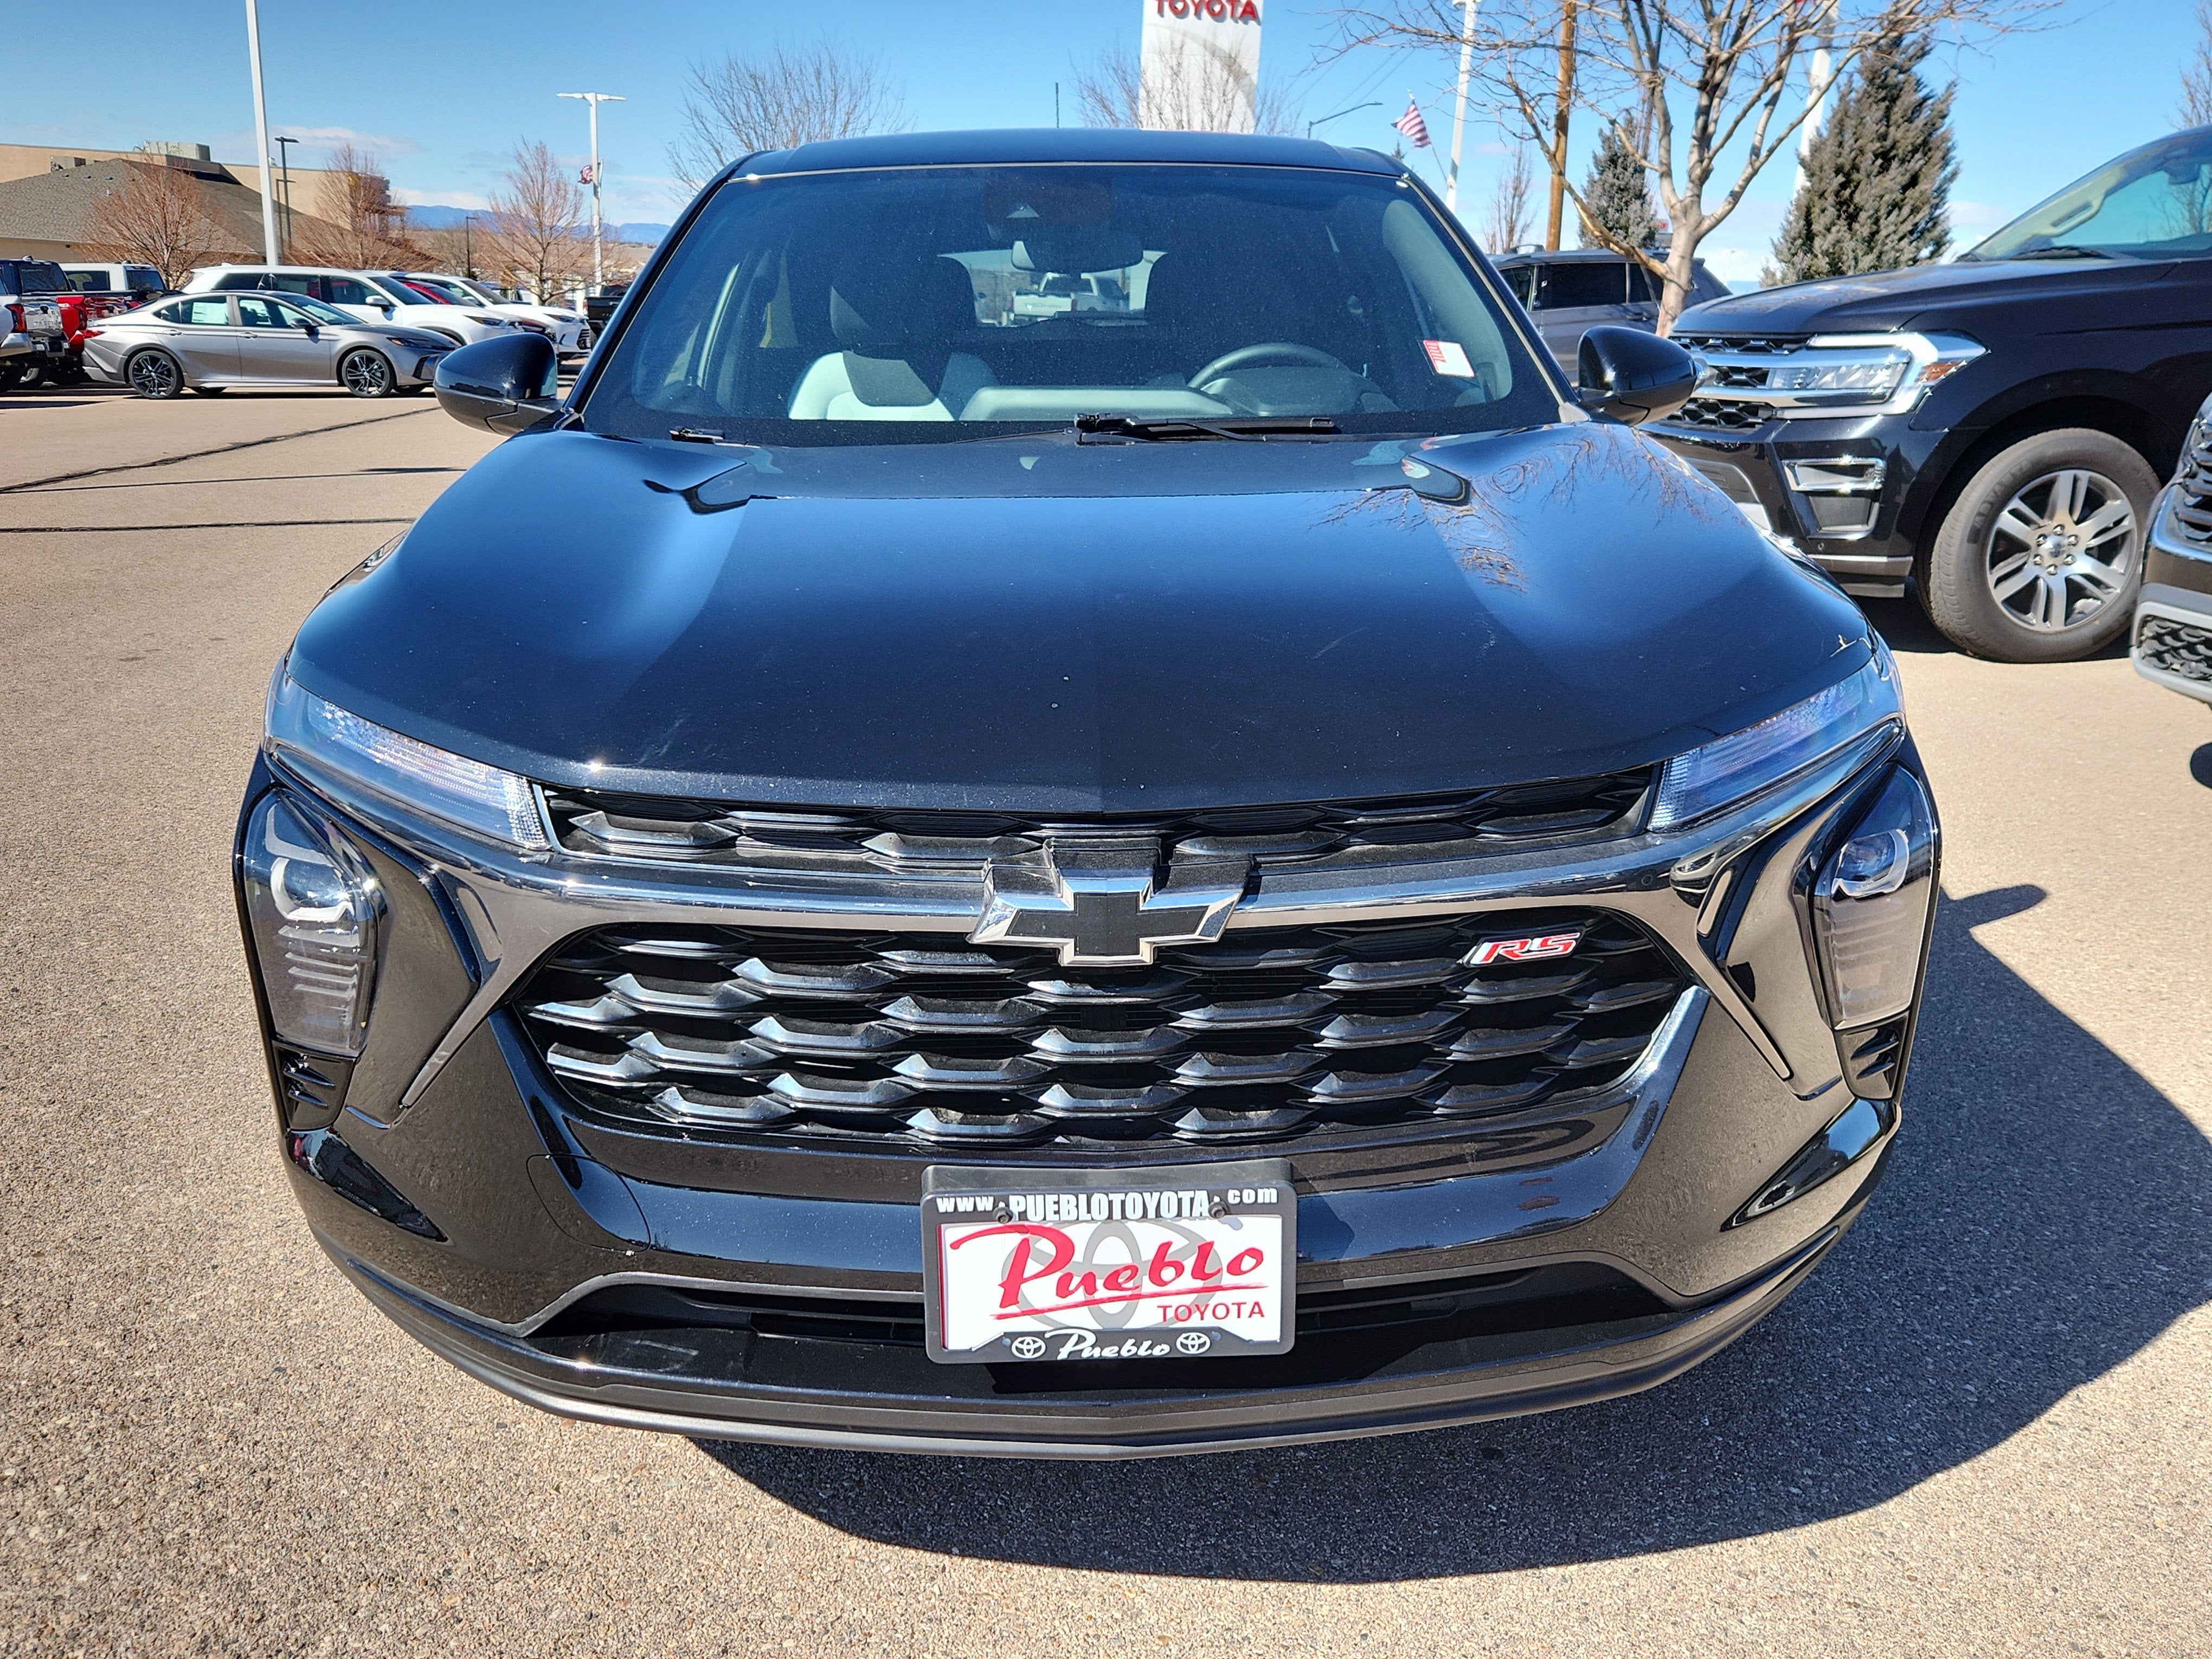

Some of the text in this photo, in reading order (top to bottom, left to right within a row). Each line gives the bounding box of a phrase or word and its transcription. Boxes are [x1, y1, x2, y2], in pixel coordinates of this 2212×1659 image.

[1155, 0, 1258, 21] TOYOTA
[1470, 932, 1580, 964] RS
[950, 1224, 1264, 1308] Pueblo
[1157, 1301, 1265, 1323] TOYOTA
[1045, 1328, 1171, 1360] Pueblo
